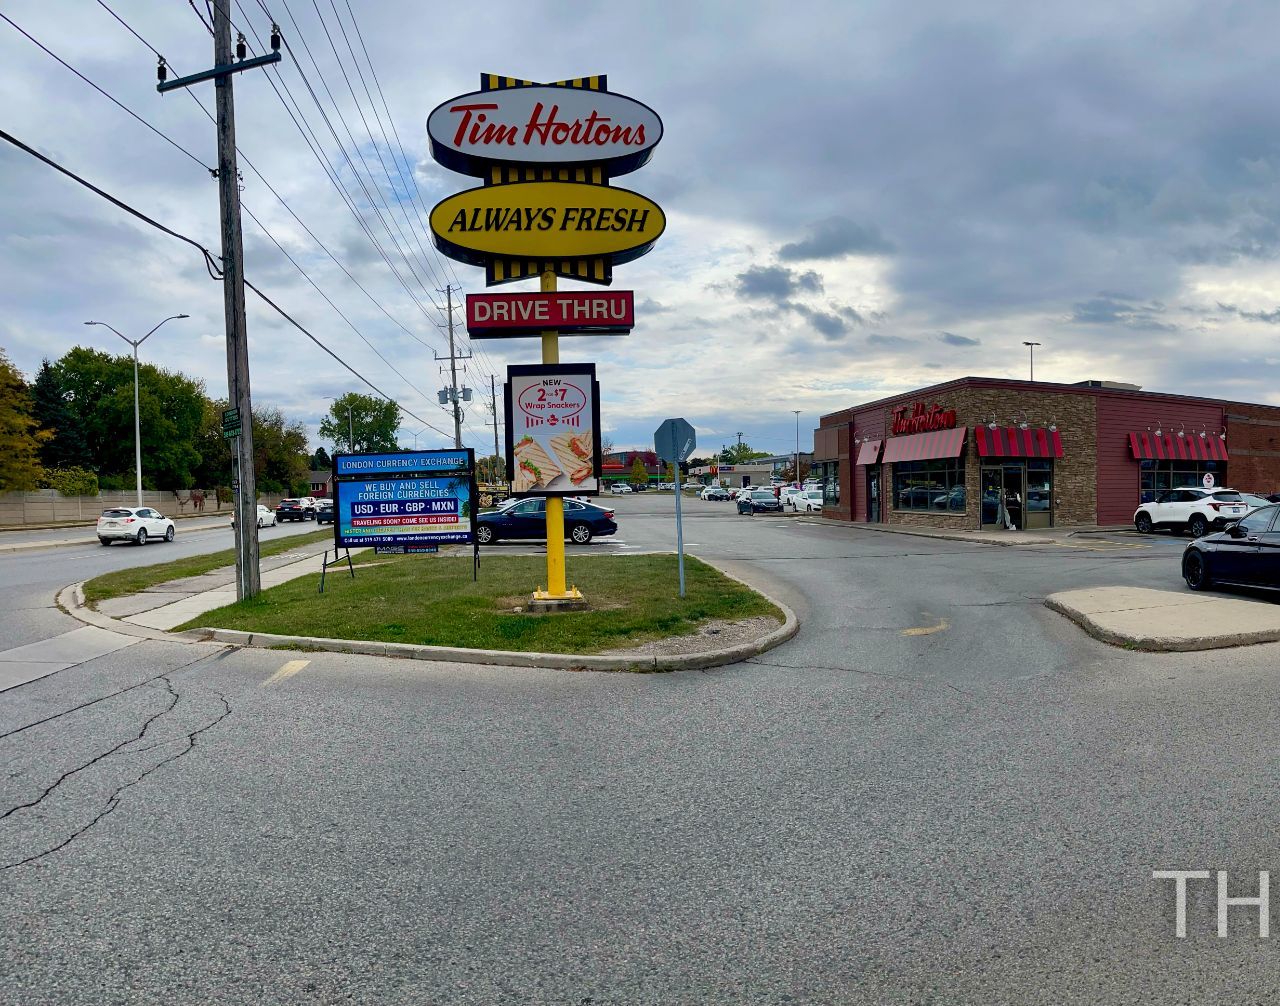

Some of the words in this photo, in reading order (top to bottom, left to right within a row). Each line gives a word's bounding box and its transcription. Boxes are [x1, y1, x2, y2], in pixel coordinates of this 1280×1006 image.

[450, 104, 518, 147] Tim
[523, 102, 646, 146] Hortons
[448, 207, 556, 232] ALWAYS
[559, 208, 649, 233] FRESH
[474, 301, 549, 322] DRIVE
[557, 299, 626, 320] THRU
[537, 388, 546, 401] 2
[342, 461, 374, 469] LONDON
[376, 459, 418, 468] CURRENCY
[420, 457, 464, 466] EXCHANGE
[420, 481, 440, 489] SELL
[359, 492, 394, 500] FOREIGN
[397, 489, 449, 499] CURRENCIES
[354, 504, 374, 514] USD
[380, 503, 399, 513] EUR
[405, 502, 425, 512] GBP
[432, 501, 454, 511] MXN
